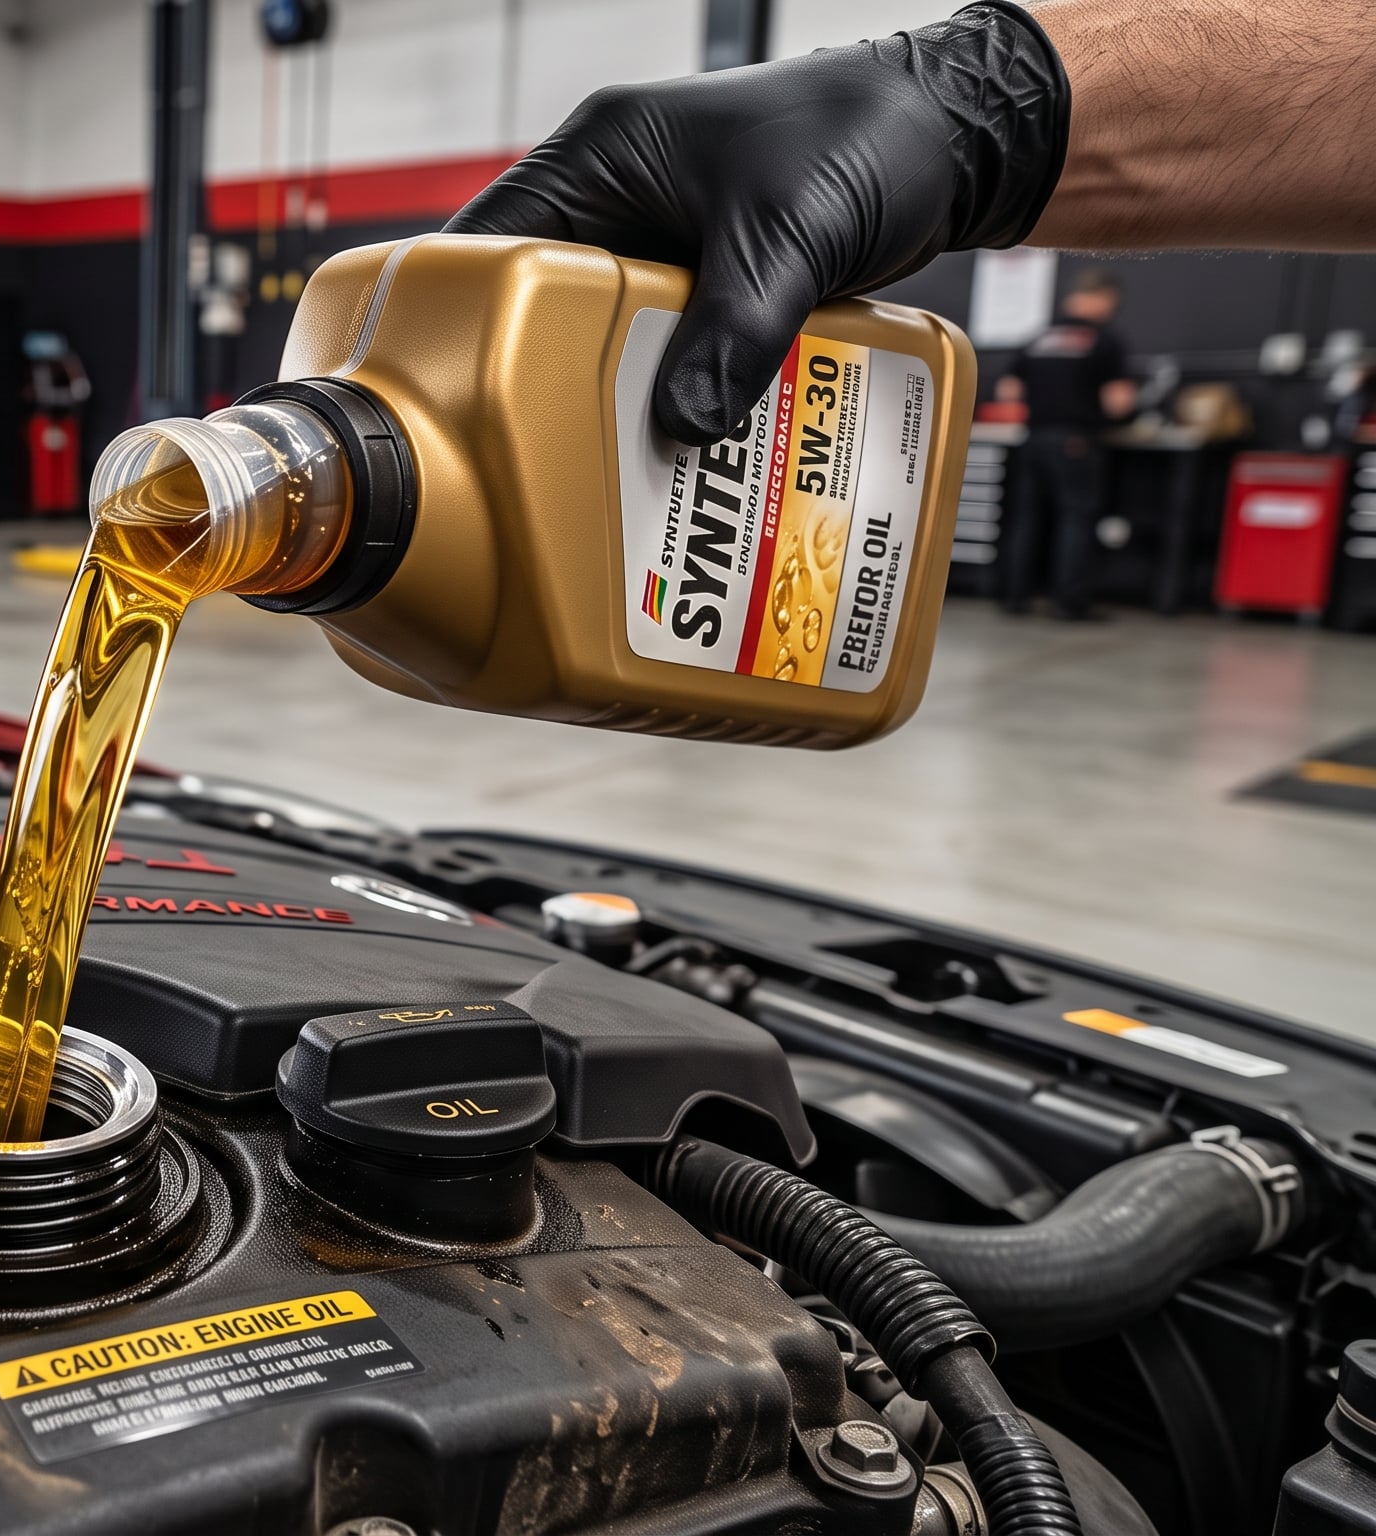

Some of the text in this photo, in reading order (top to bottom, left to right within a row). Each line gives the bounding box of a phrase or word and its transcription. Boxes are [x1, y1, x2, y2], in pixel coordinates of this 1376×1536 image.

[795, 355, 839, 496] 5W-30
[863, 512, 892, 559] OIL
[426, 1098, 499, 1119] OIL
[50, 1332, 192, 1378] CAUTION:
[193, 1307, 302, 1345] ENGINE
[302, 1299, 353, 1321] OIL
